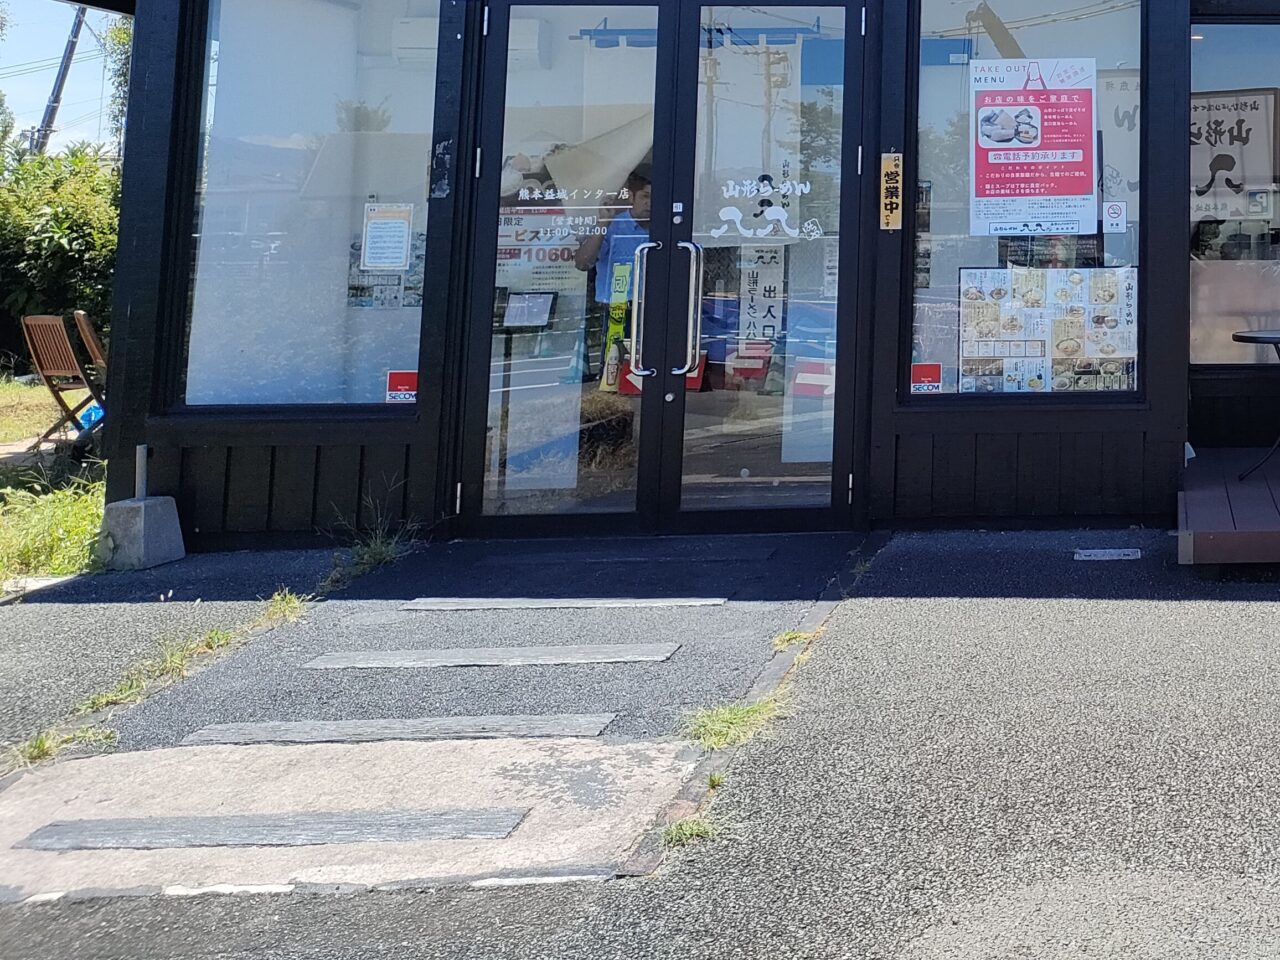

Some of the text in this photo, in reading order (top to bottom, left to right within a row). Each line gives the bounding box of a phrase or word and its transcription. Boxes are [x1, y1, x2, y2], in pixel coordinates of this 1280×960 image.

[1005, 65, 1027, 73] OUT
[984, 95, 1081, 103] お店の味をご家庭で
[721, 179, 811, 199] 山形らーめん
[884, 171, 900, 214] 営業中
[518, 188, 631, 201] 熊本益城インター店
[911, 384, 940, 392] SECOM
